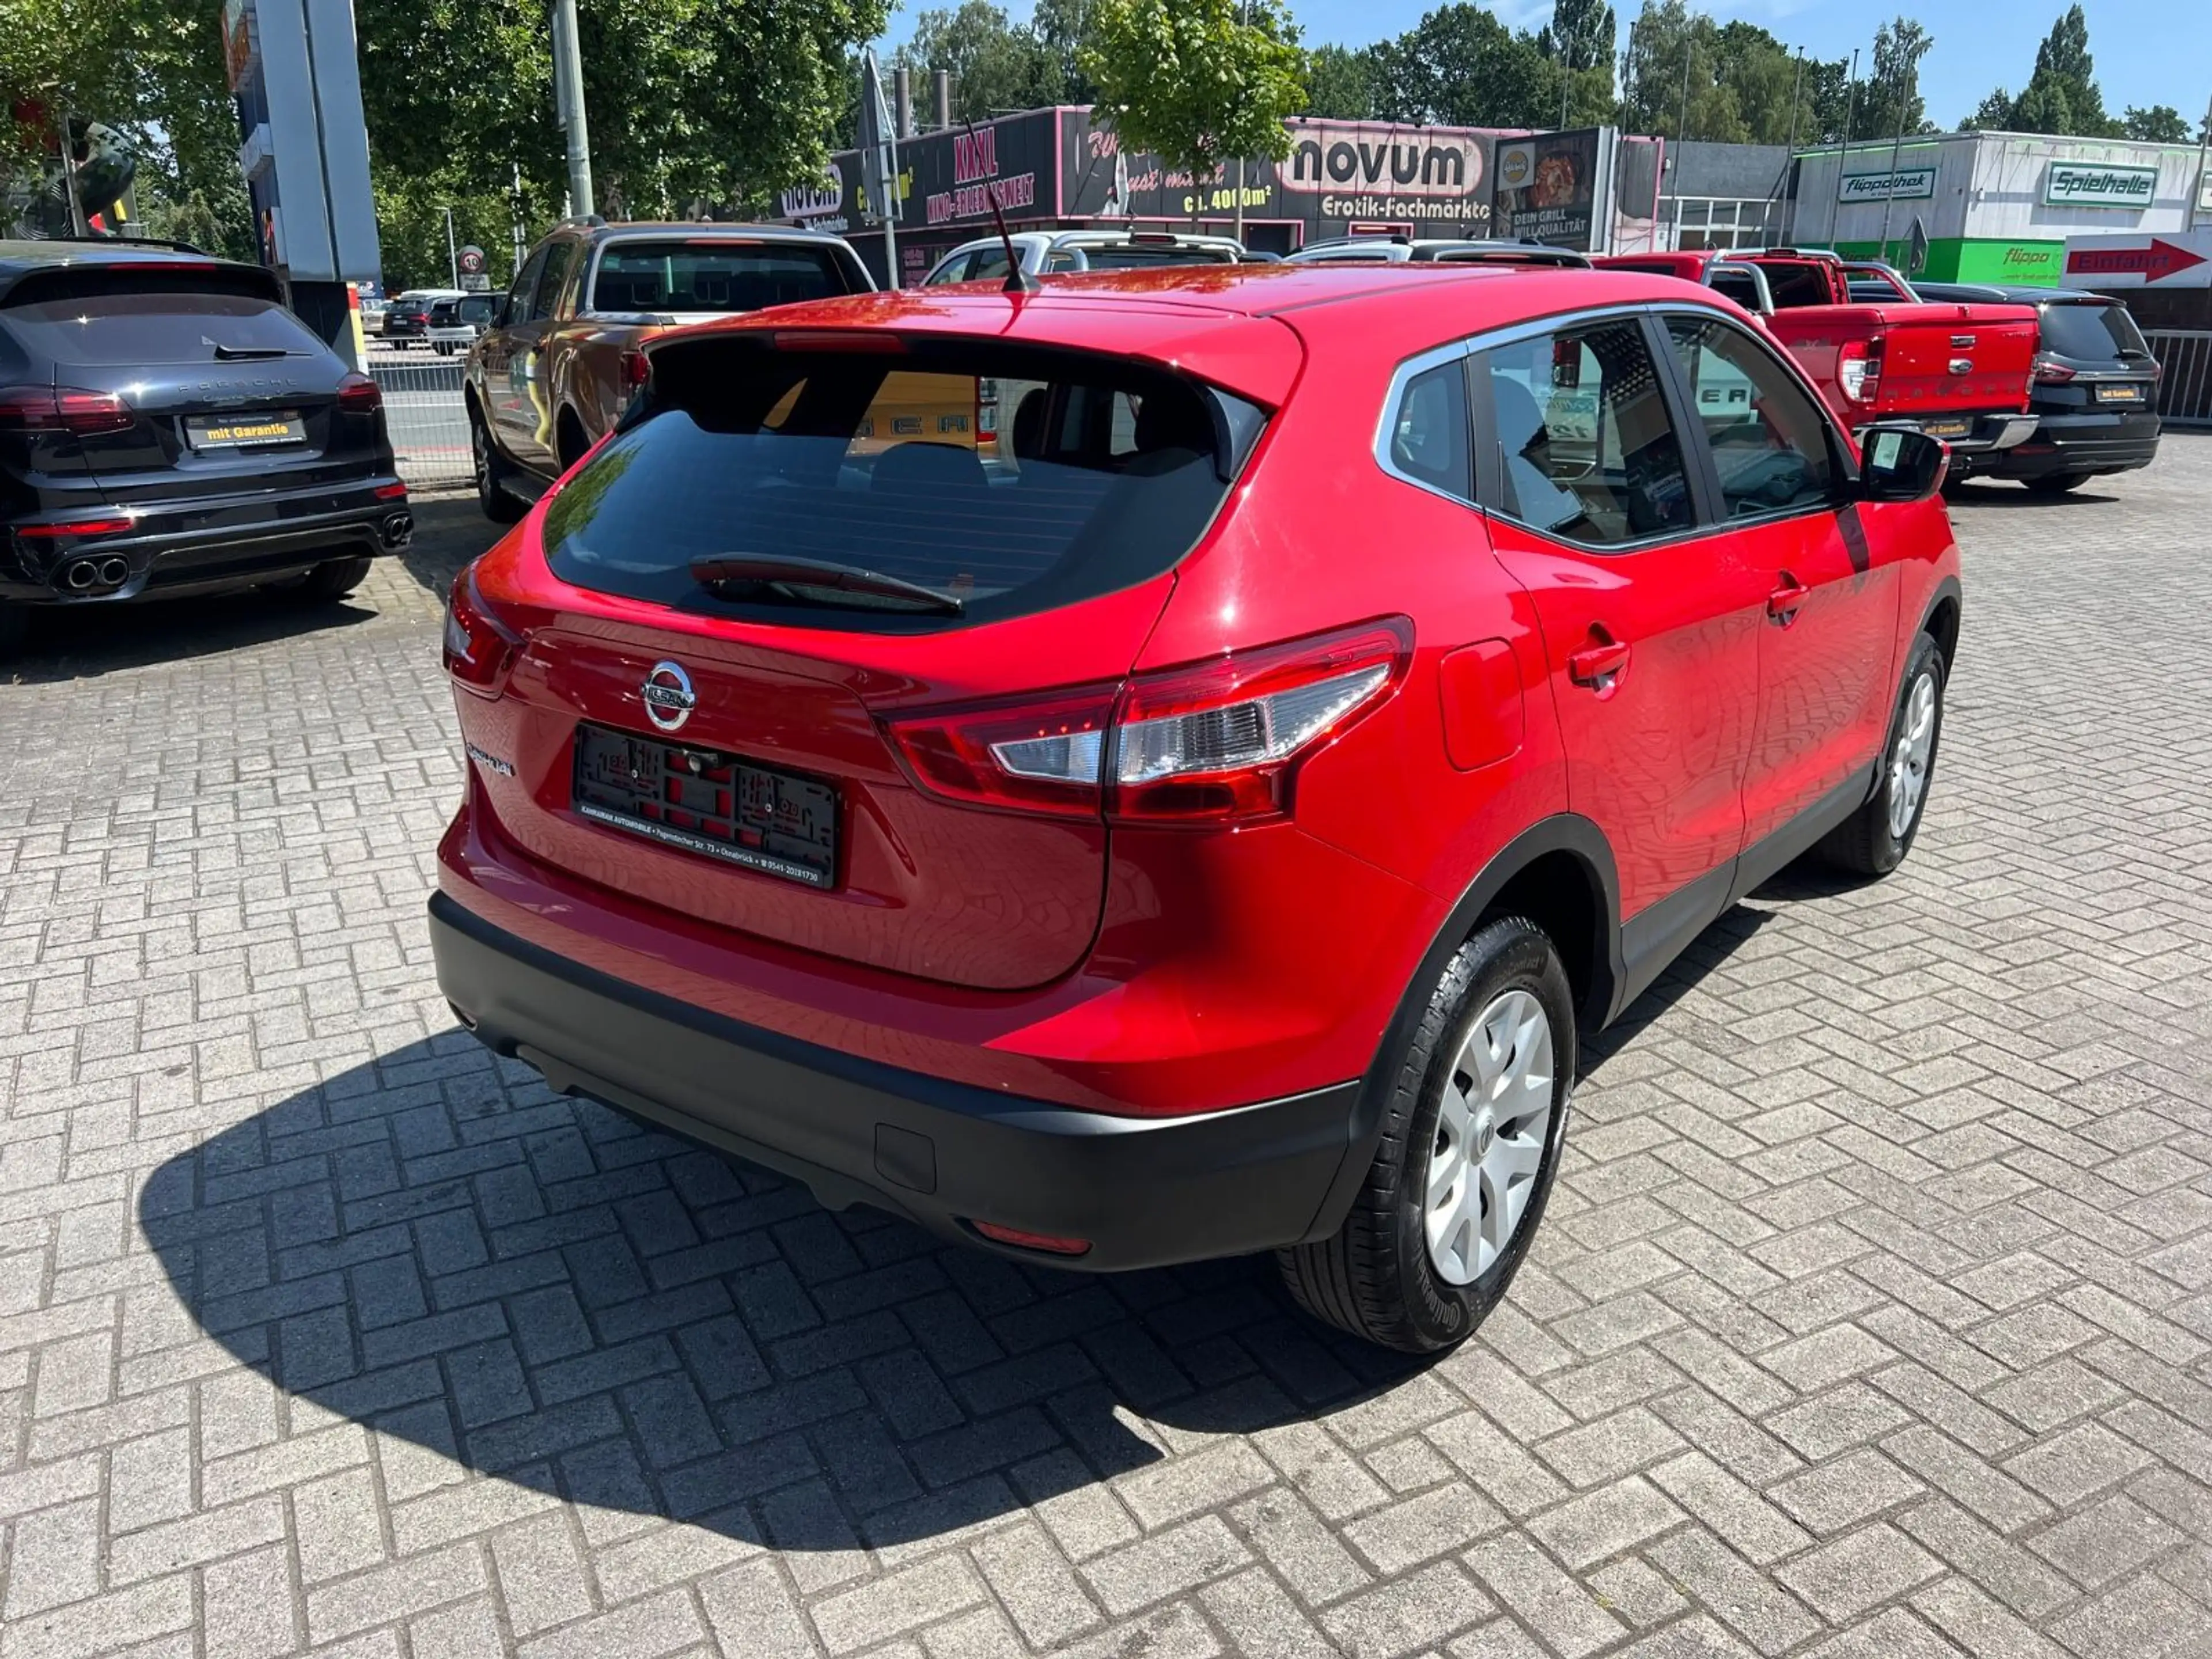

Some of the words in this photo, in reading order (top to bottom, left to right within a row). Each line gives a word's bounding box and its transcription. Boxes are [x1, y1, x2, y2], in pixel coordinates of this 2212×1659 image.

[954, 127, 999, 184] XXXL
[1845, 174, 1926, 194] flippothek
[2055, 171, 2151, 195] Spielhalle
[1322, 195, 1491, 219] Erotik-Fachmärkte
[1514, 211, 1537, 225] DEIN
[1539, 209, 1567, 222] GRILL
[1514, 225, 1537, 237] WILL
[1538, 219, 1586, 236] QUALITÄT
[467, 258, 478, 267] 10
[2003, 247, 2050, 265] flippo
[2079, 254, 2170, 270] Einfahrt
[207, 428, 231, 440] mit
[233, 423, 289, 438] Garantie
[721, 847, 754, 863] Osnabrück
